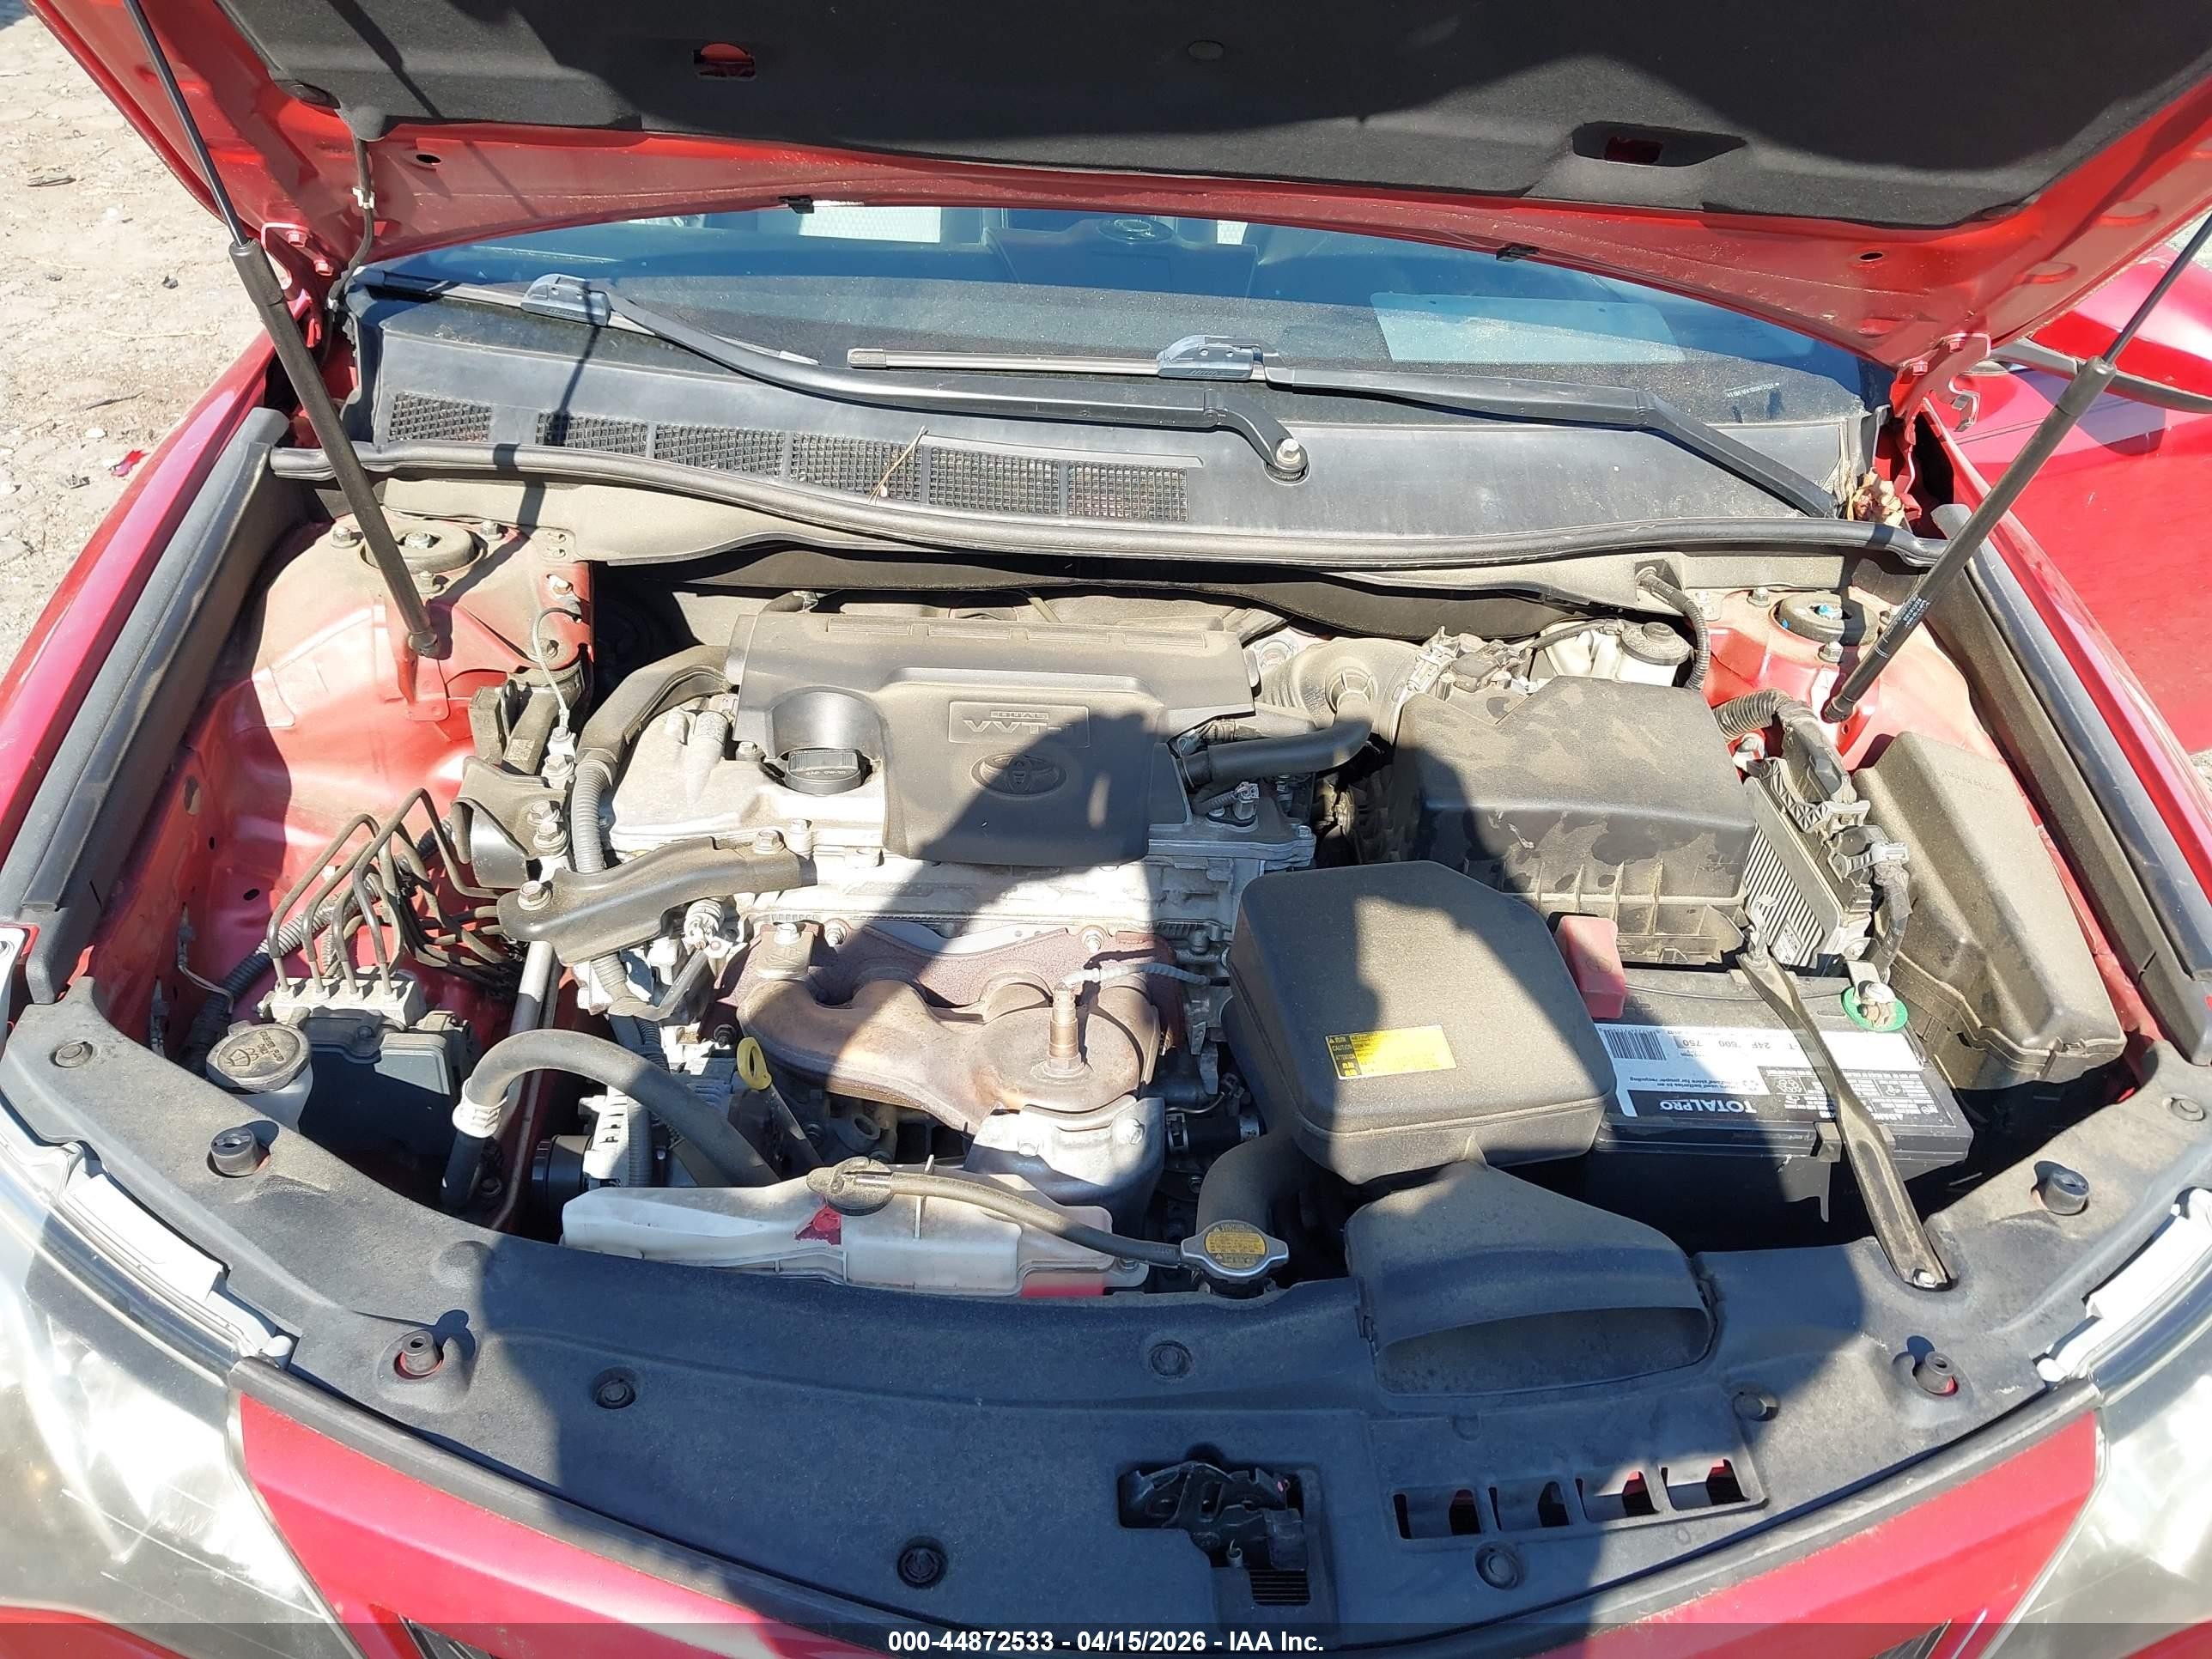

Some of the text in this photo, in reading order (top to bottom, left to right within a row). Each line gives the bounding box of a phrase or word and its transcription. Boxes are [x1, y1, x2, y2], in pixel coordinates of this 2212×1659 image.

[1332, 1043, 1352, 1052] CAUTION
[1682, 1038, 1703, 1048] 750
[1659, 1099, 1758, 1114] TOTALPRO
